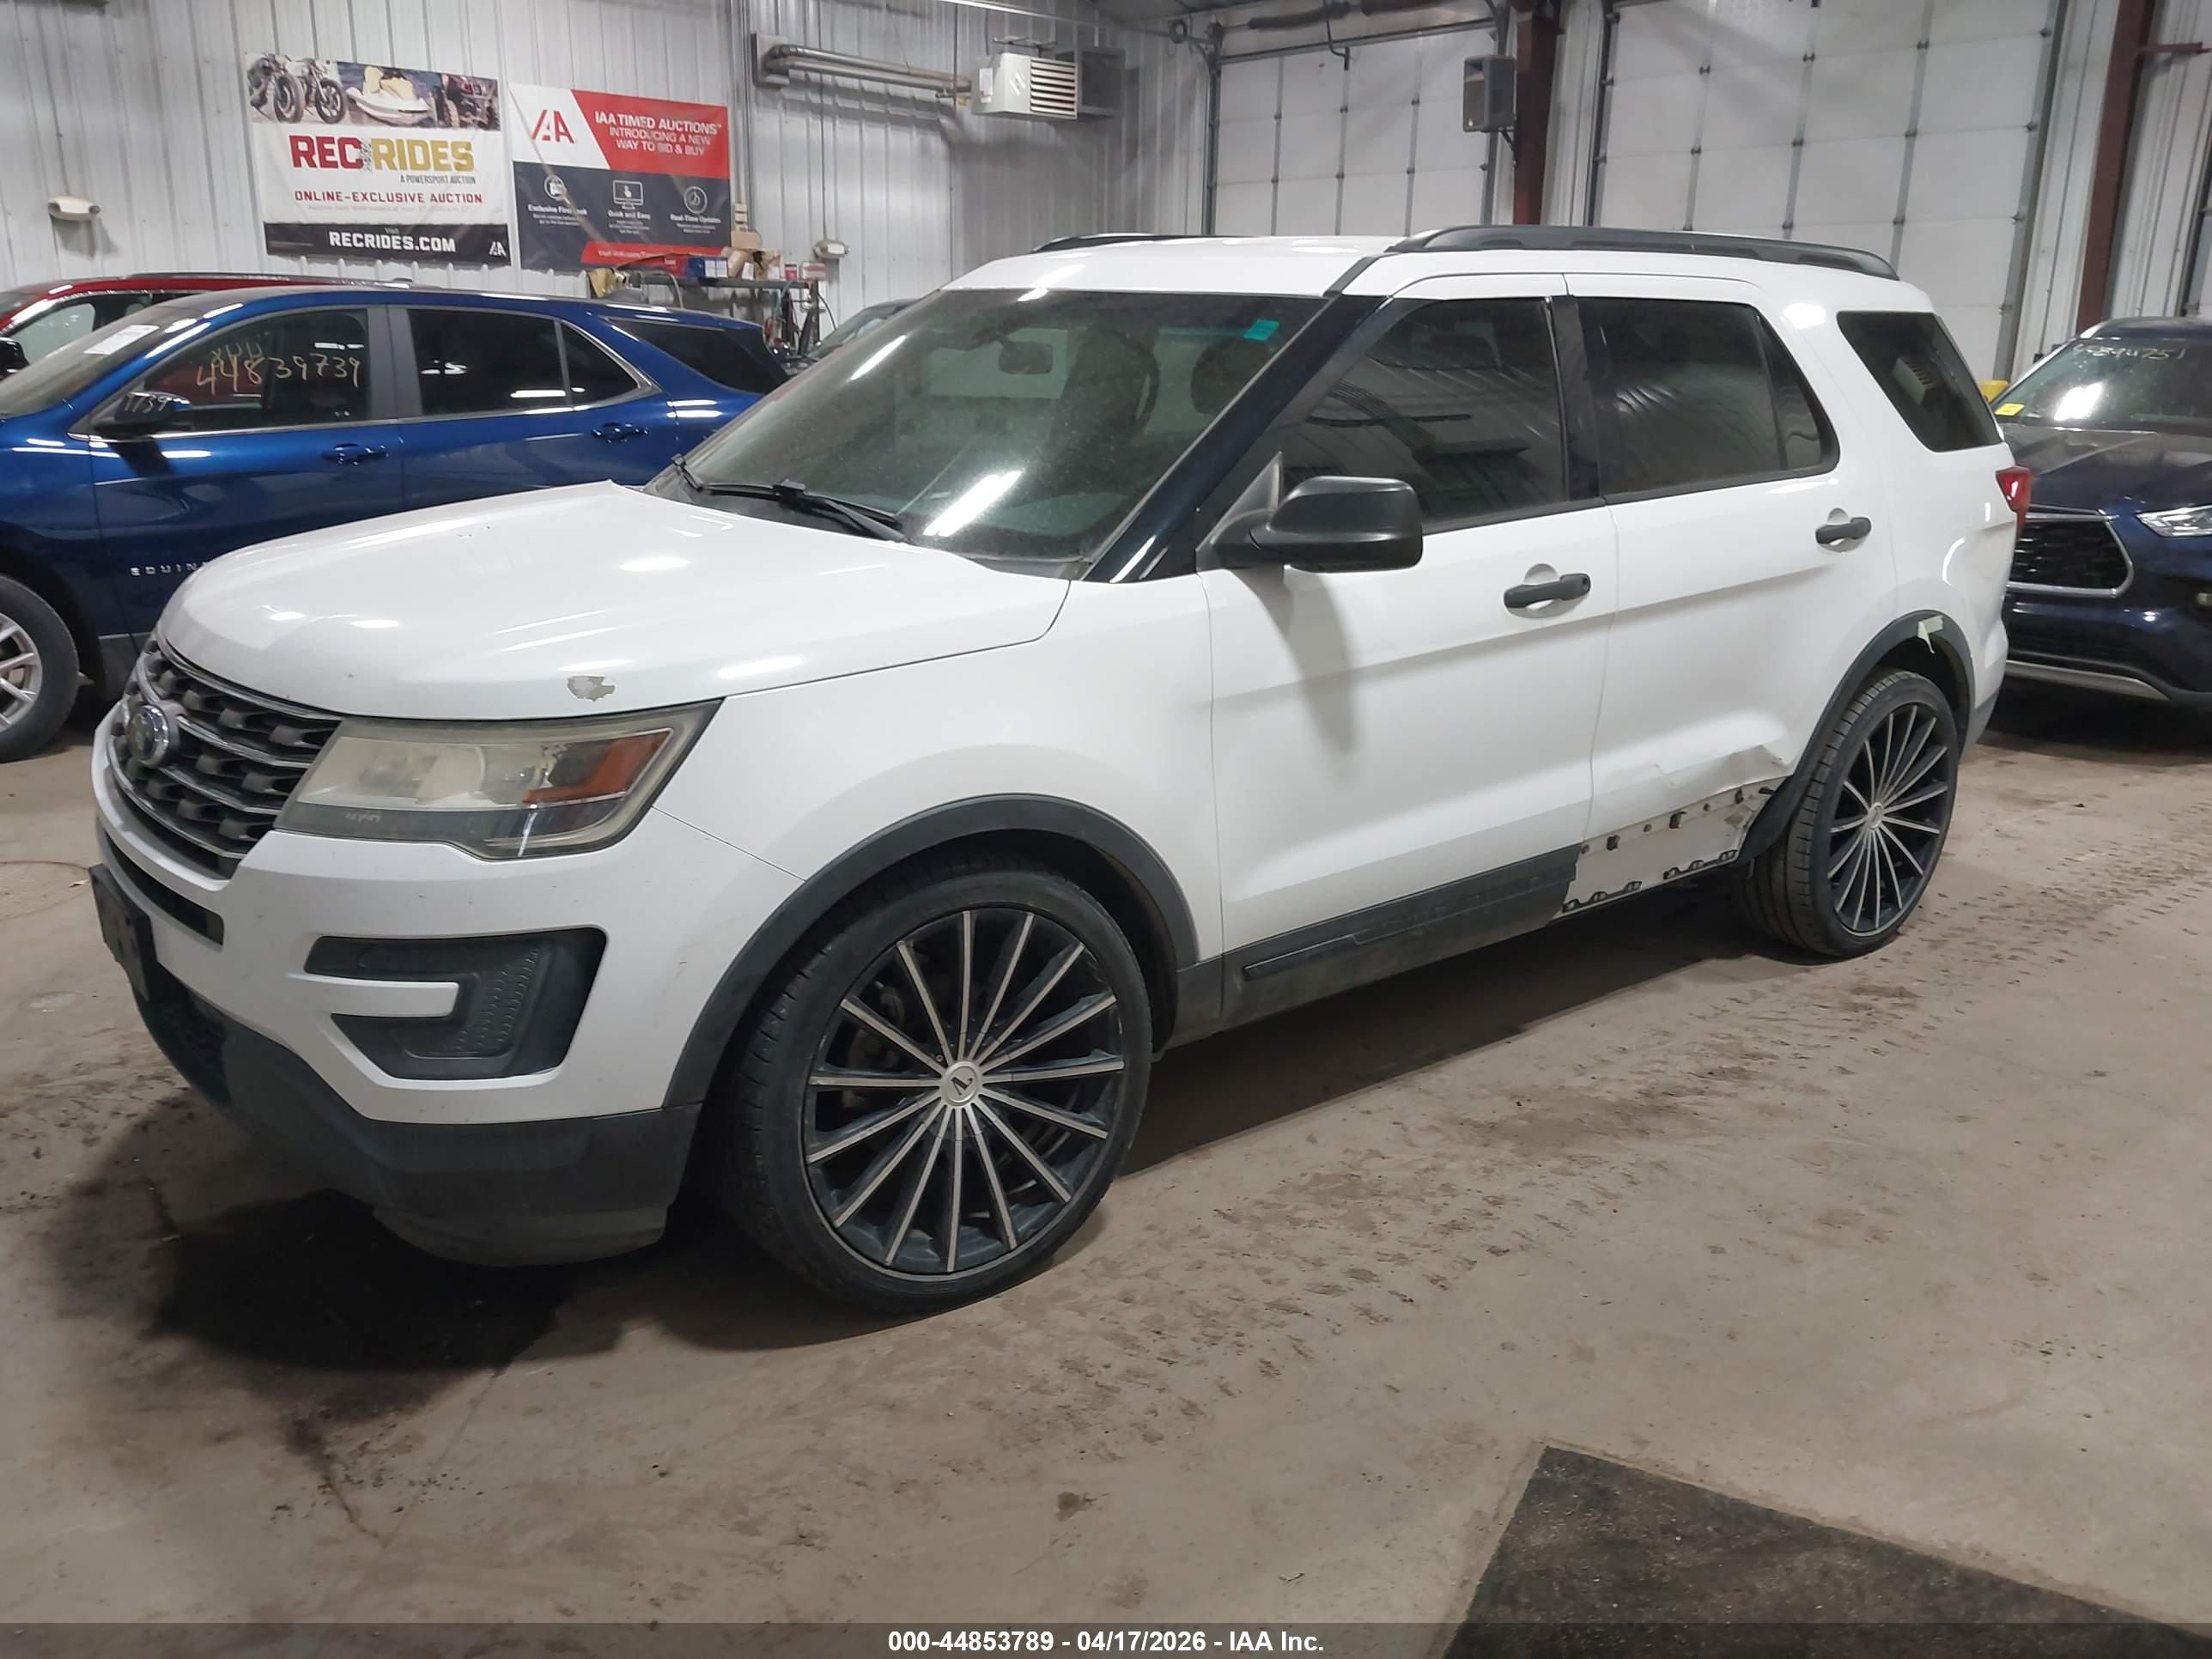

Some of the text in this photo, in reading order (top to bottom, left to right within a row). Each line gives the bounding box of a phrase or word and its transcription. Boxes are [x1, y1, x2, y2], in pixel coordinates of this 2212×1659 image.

[595, 112, 617, 125] IAA
[617, 114, 655, 129] TIMED
[610, 127, 677, 143] INTRODUCING
[688, 135, 711, 145] NEW
[289, 135, 476, 172] REC RIDES
[617, 139, 640, 151] WAY
[641, 141, 655, 152] TO
[675, 144, 683, 154] &
[685, 145, 705, 155] BUY
[400, 174, 476, 185] A POWERSPORT AUCTION
[295, 191, 483, 204] ONLINE-EXCLUSIVE AUCTION
[328, 231, 457, 252] RECRIDES.COM
[197, 354, 361, 395] 44839739
